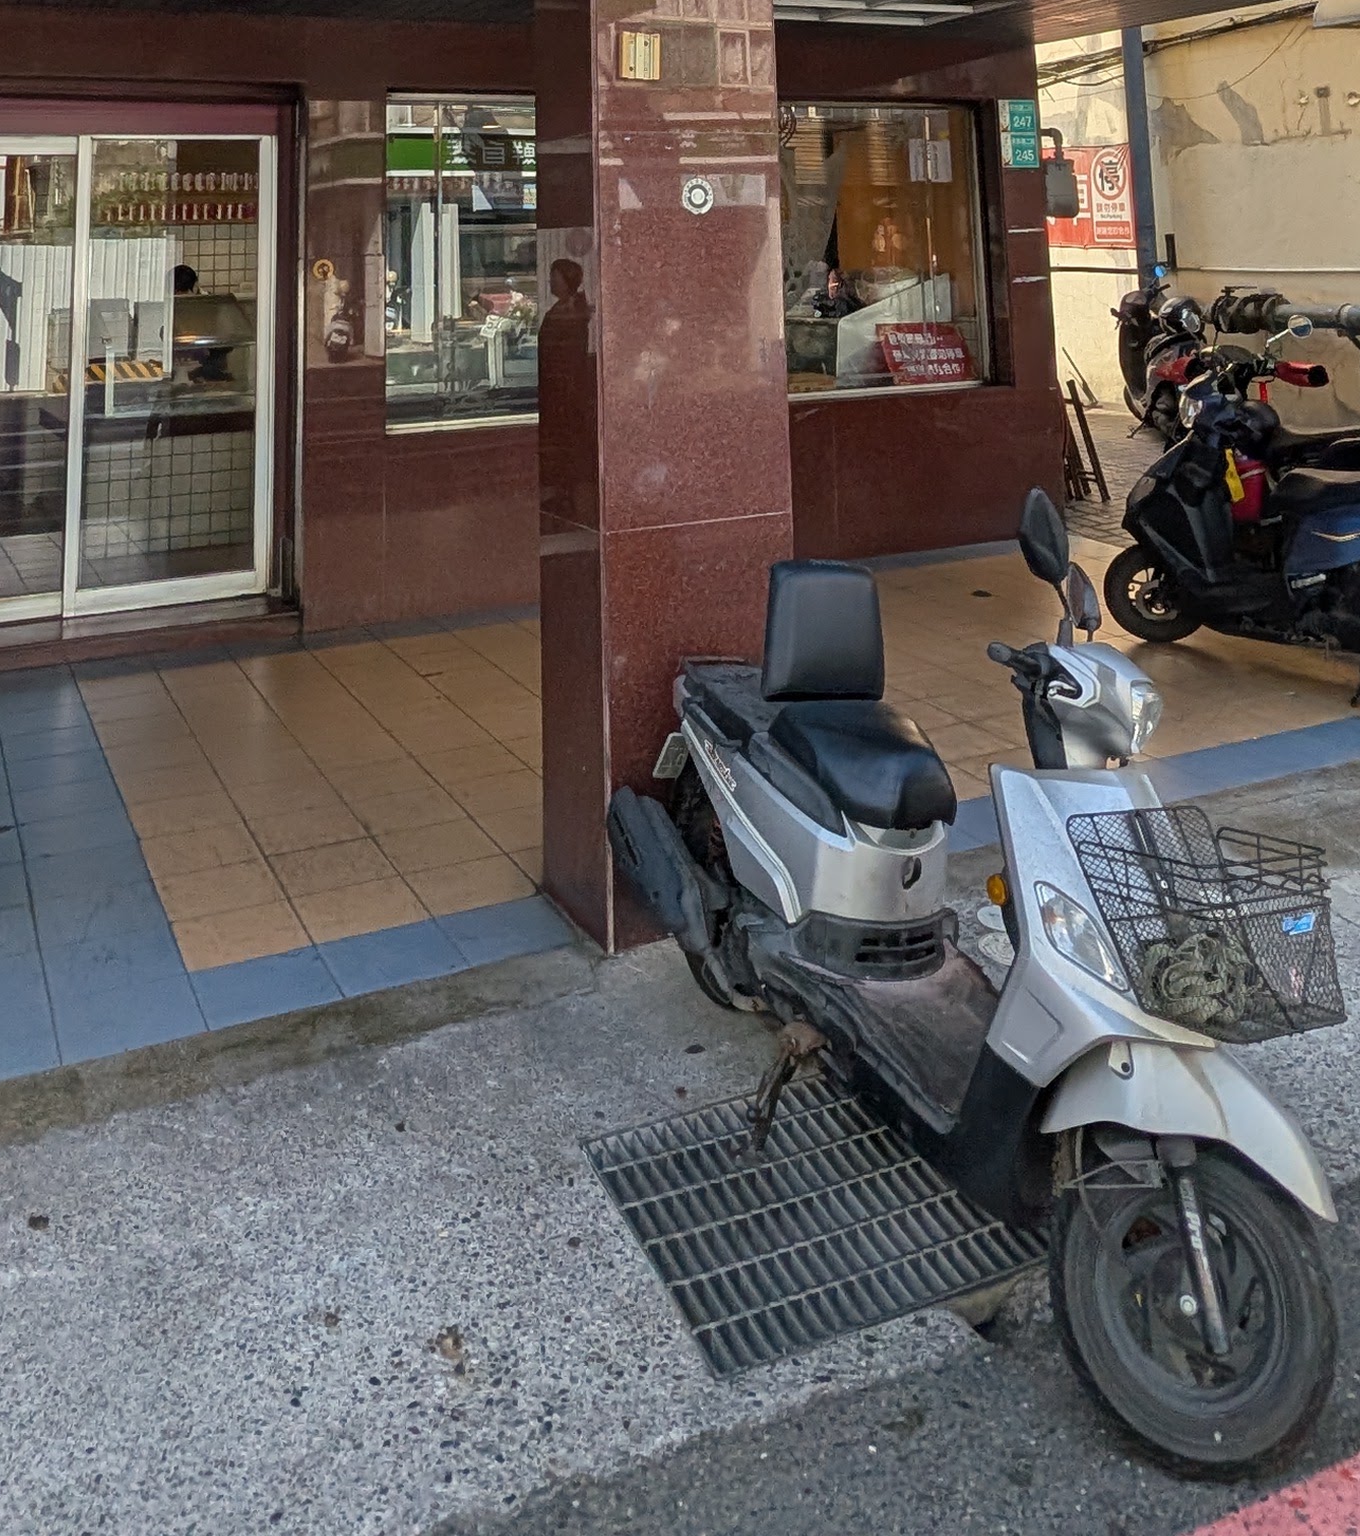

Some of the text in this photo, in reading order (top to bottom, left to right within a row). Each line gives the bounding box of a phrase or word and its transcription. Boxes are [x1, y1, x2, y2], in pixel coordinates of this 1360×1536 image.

[1013, 116, 1032, 128] 247
[1015, 149, 1035, 161] 245
[1099, 160, 1121, 192] 停
